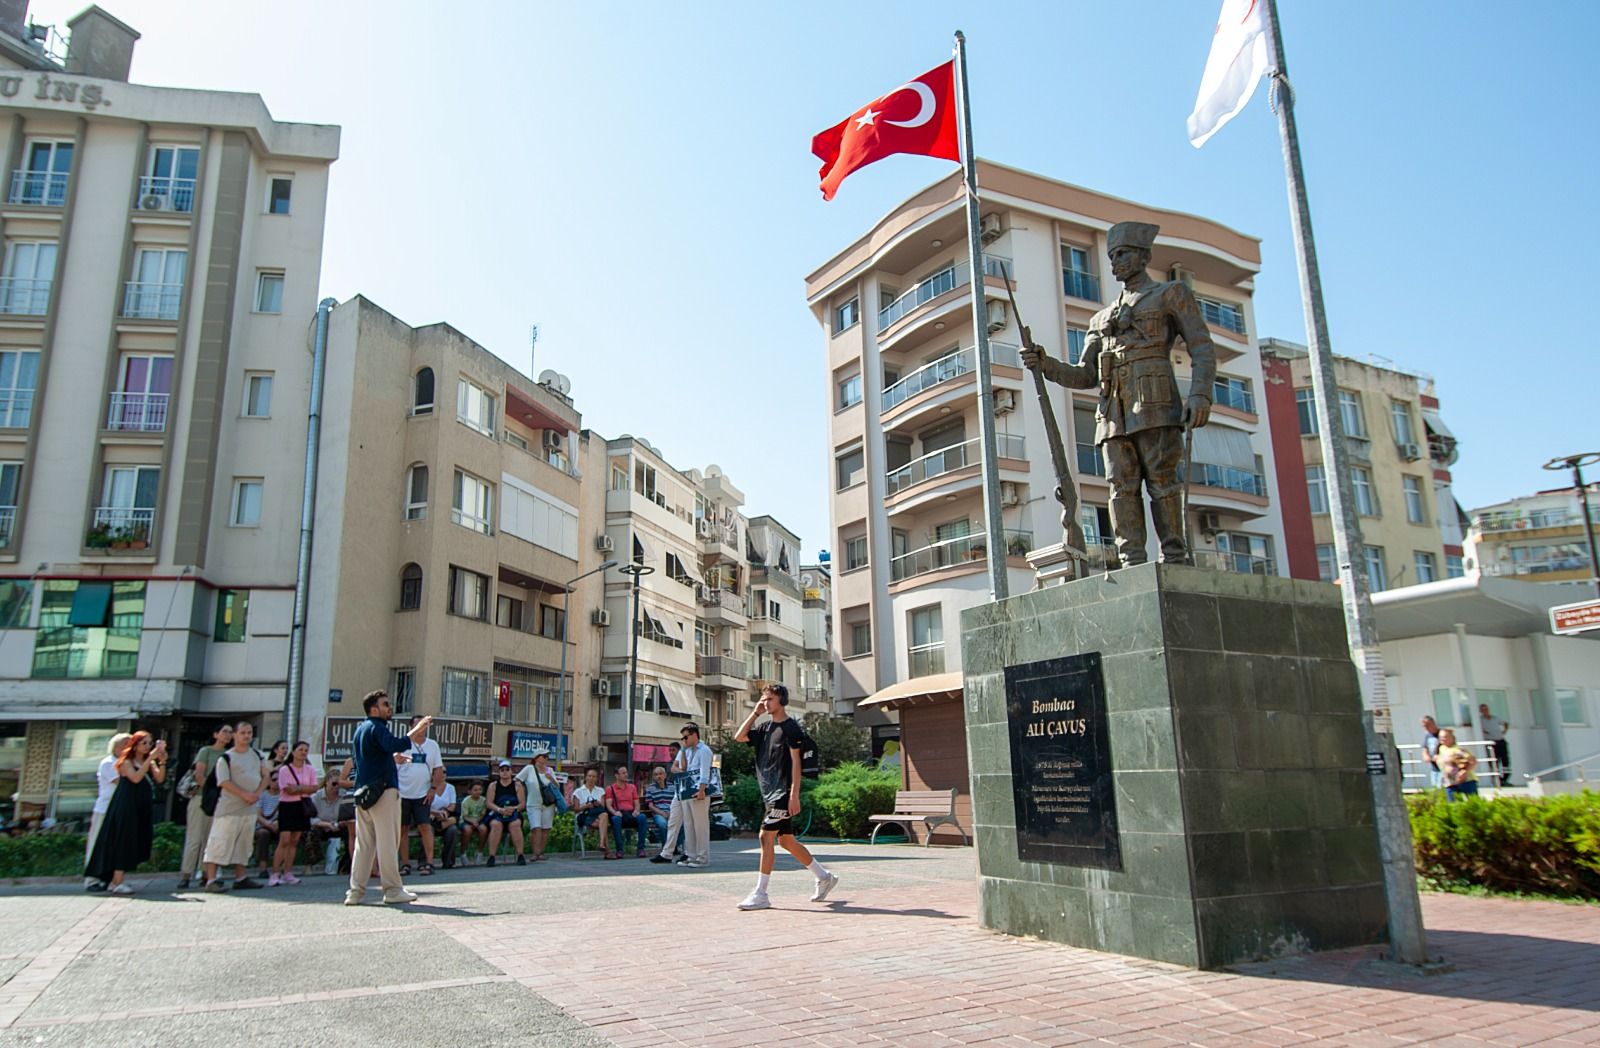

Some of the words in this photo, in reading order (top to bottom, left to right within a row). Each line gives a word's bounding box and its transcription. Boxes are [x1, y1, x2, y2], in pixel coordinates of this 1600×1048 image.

[34, 73, 112, 110] İNŞ.
[1032, 697, 1075, 714] Bombacı
[435, 721, 466, 744] YILDIZ
[467, 722, 488, 745] PİDE
[1026, 719, 1045, 737] ALİ
[1047, 718, 1086, 740] ÇAVUŞ
